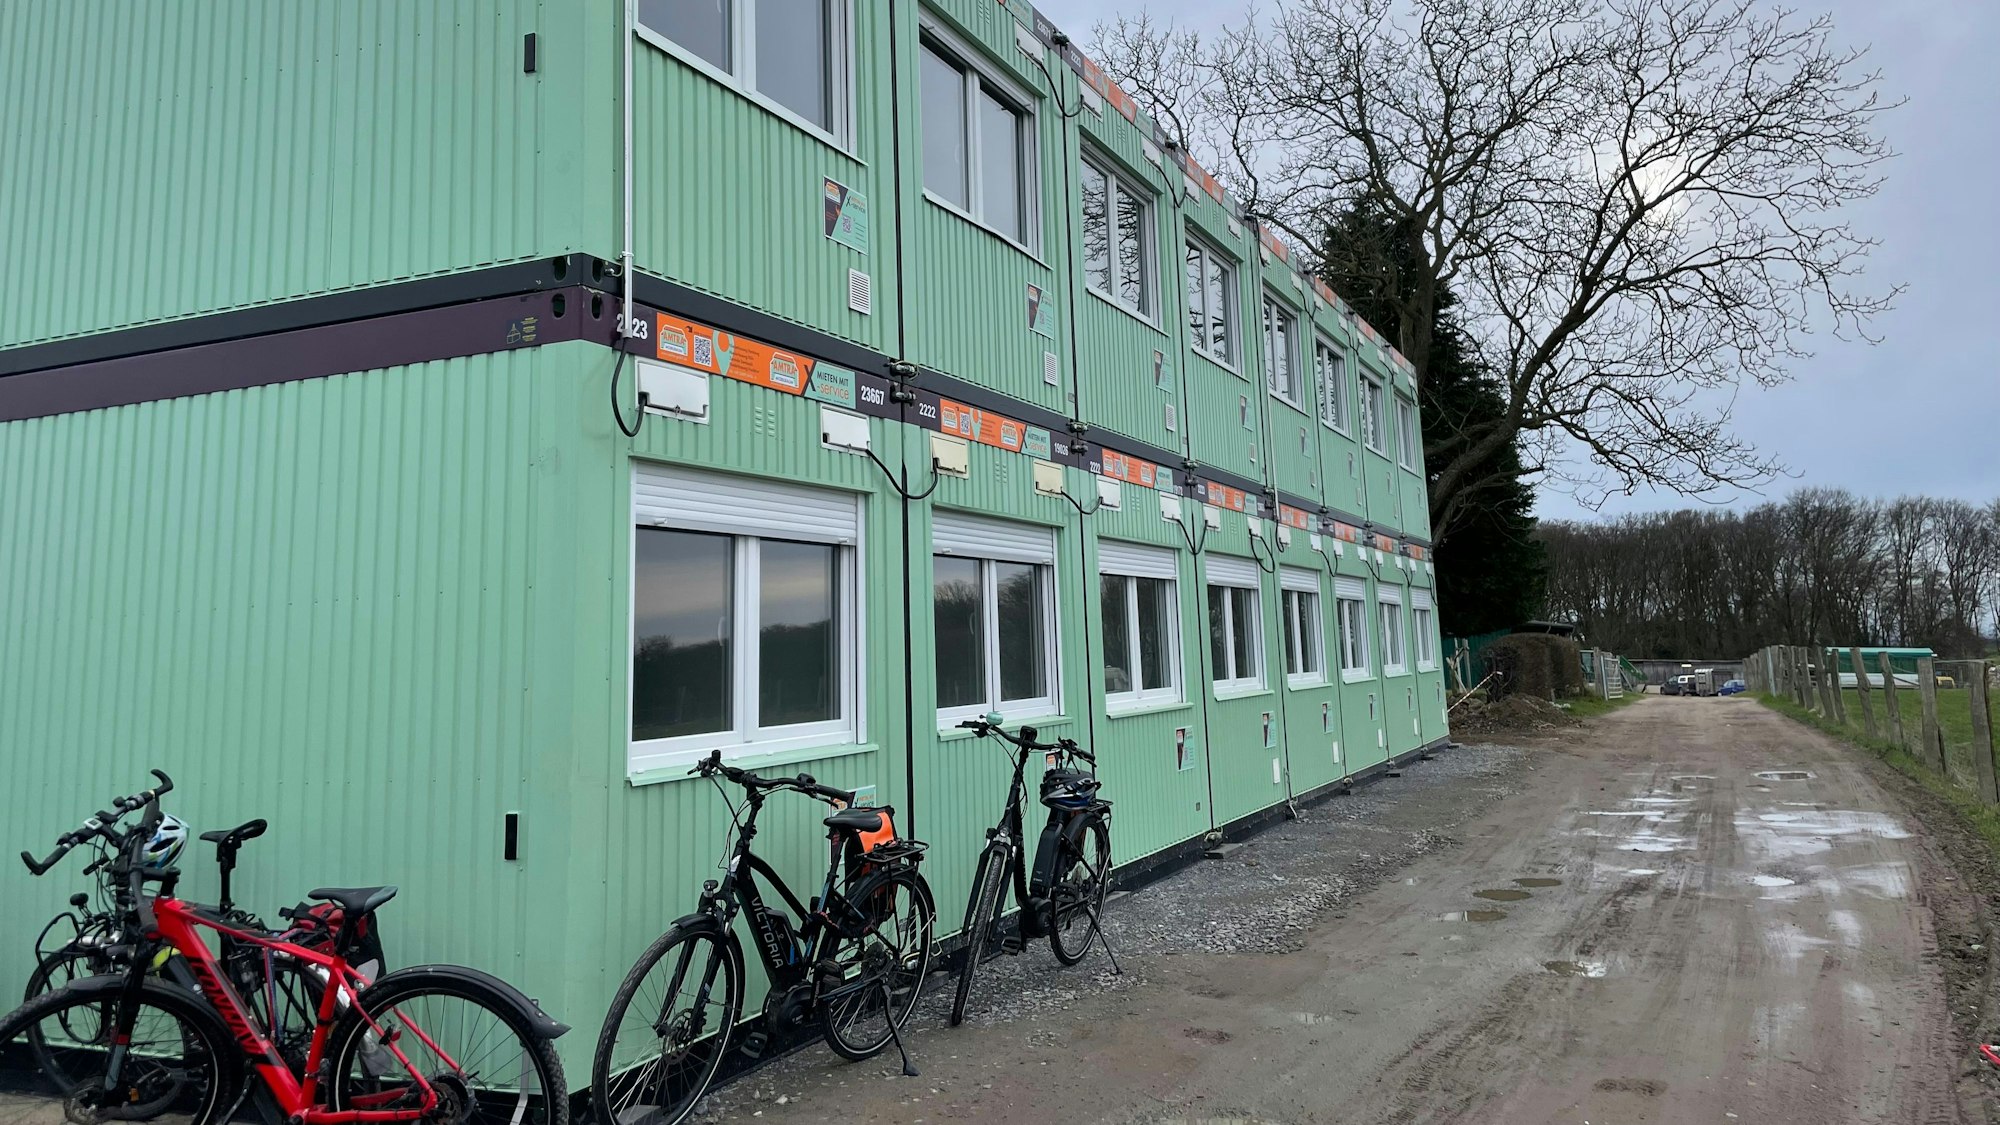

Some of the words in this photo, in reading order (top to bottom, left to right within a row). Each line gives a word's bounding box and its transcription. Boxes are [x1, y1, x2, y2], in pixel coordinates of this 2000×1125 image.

[616, 313, 648, 340] 223
[816, 370, 838, 384] MIETEN
[839, 377, 849, 387] MIT
[860, 385, 885, 406] 23667
[919, 402, 937, 419] 2222
[751, 896, 784, 969] VICTORIA
